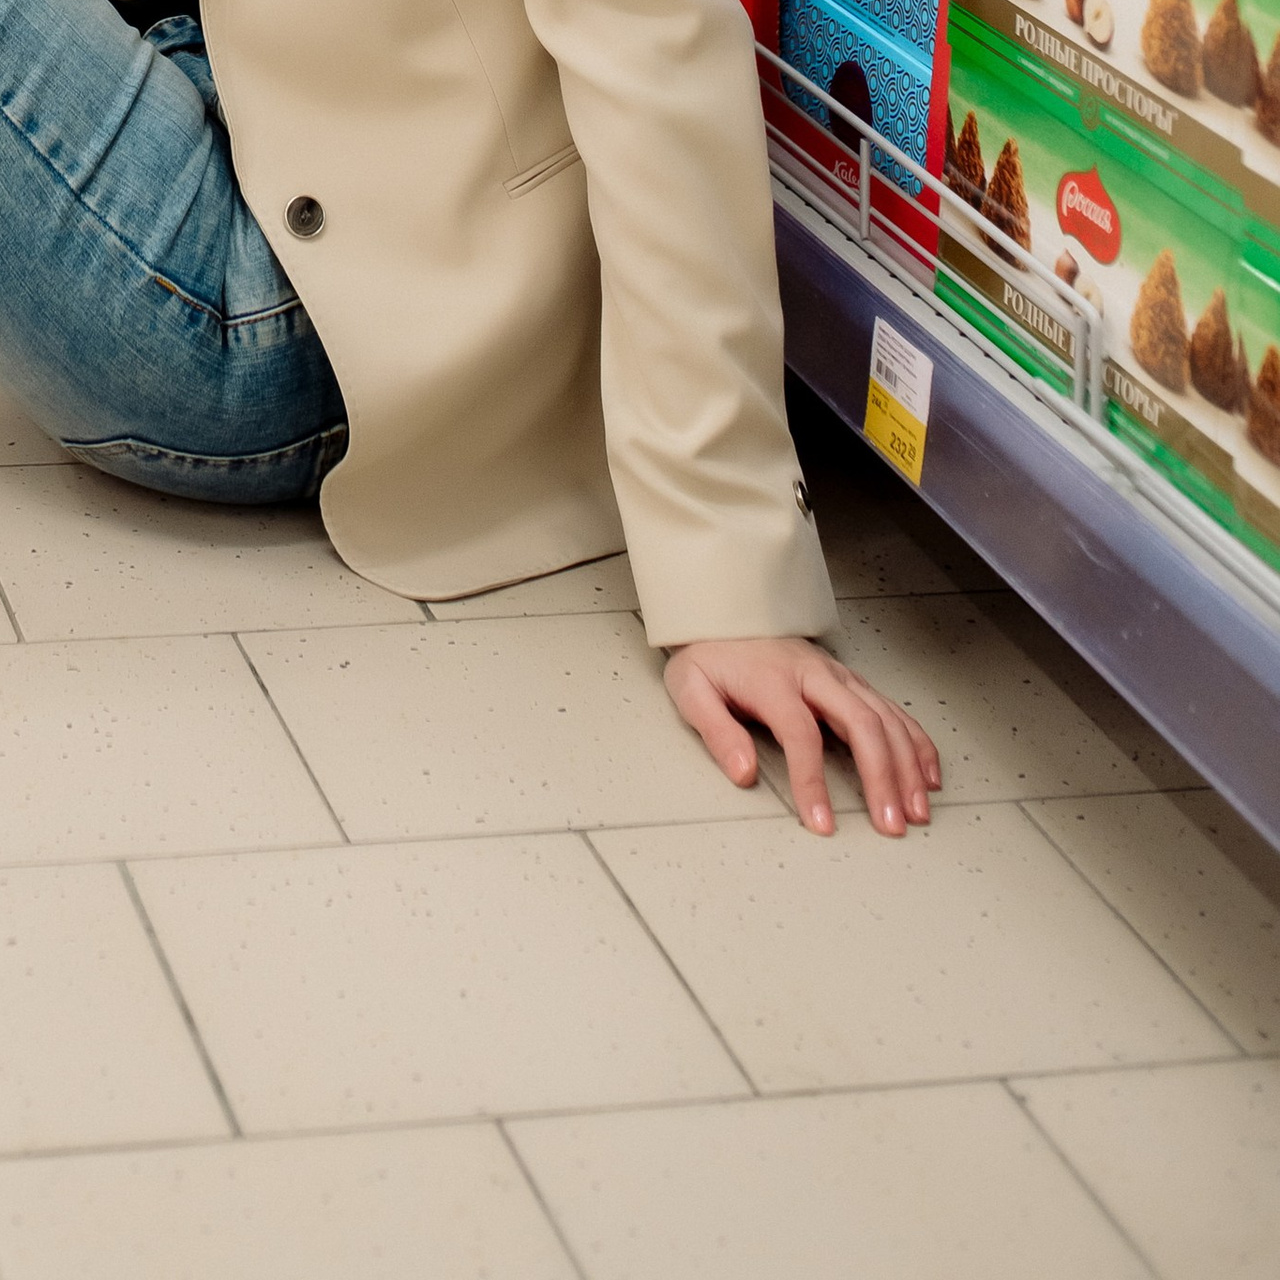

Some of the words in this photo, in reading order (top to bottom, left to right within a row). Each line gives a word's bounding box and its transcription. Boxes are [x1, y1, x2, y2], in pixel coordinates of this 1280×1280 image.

[1014, 13, 1081, 76] РОДНЫЕ
[1080, 55, 1174, 137] ПРОСТОРЫ
[1002, 281, 1068, 353] РОДНЫЕ
[889, 431, 908, 461] 232
